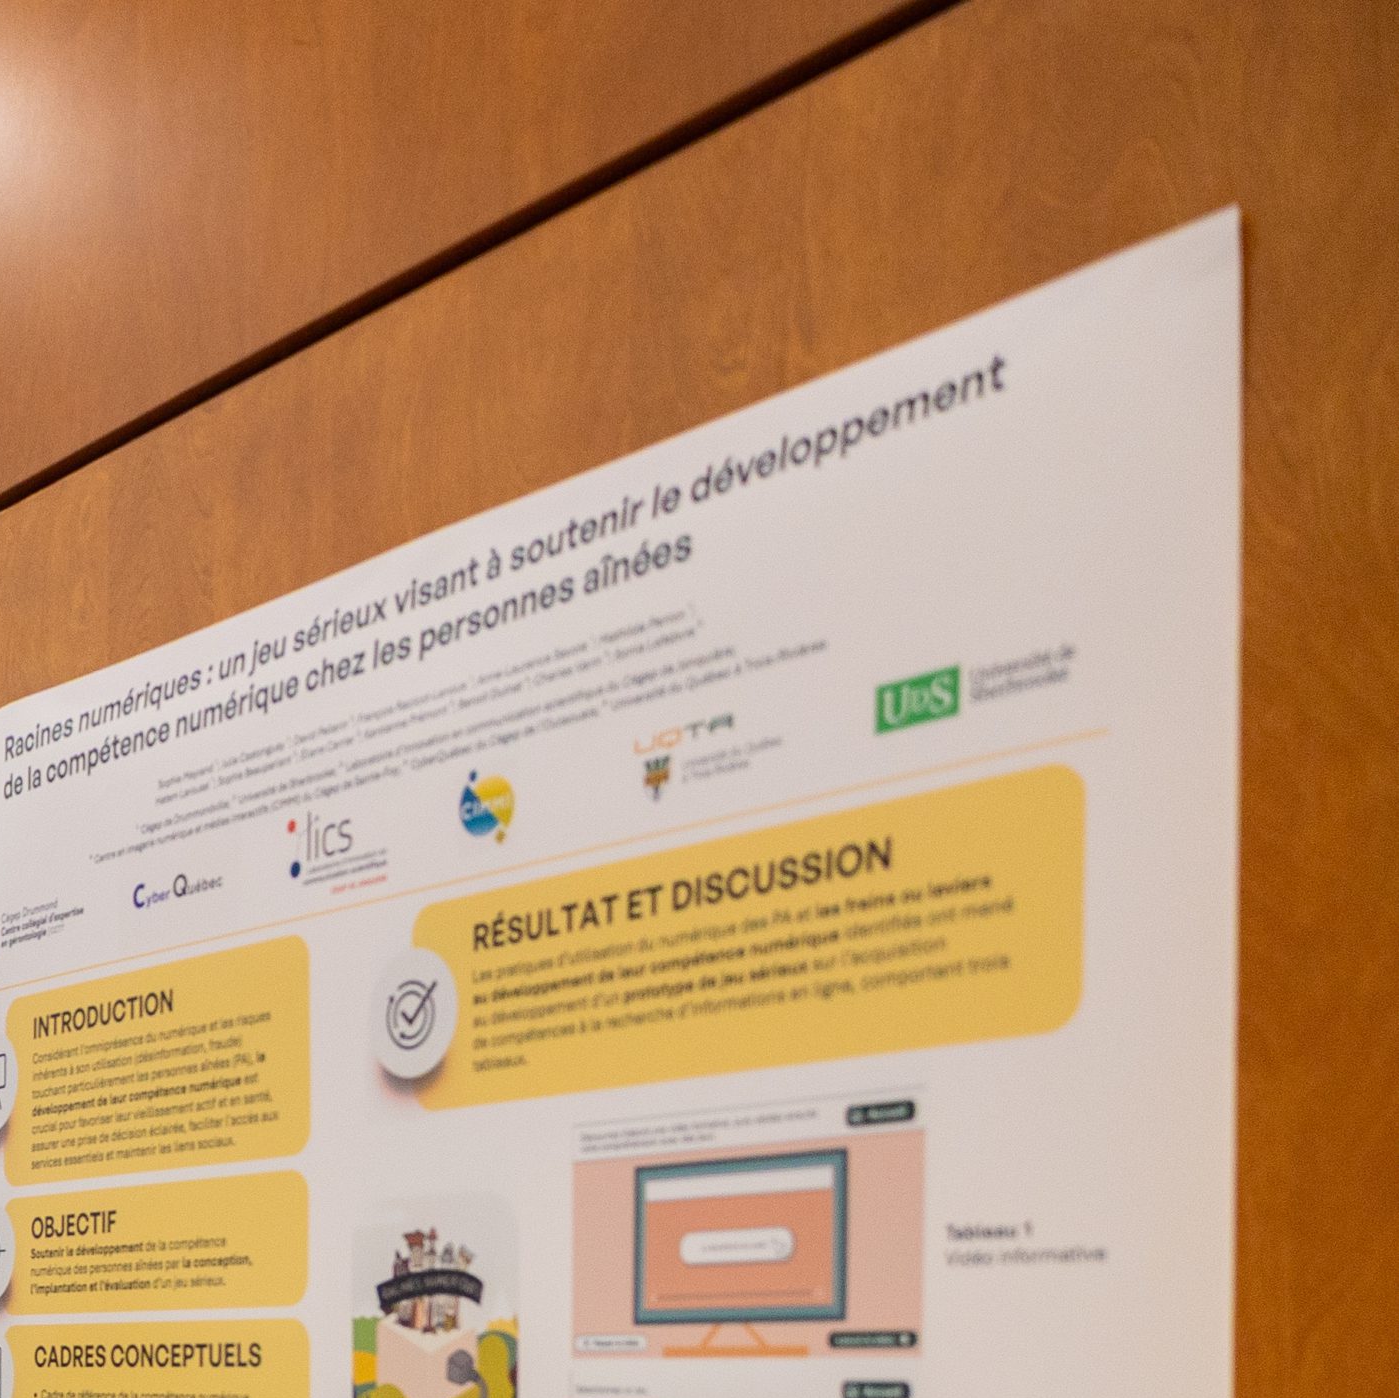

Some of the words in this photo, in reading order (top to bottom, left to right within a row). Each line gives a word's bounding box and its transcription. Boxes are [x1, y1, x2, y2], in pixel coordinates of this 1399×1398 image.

[4, 718, 73, 760] Racines
[78, 669, 201, 731] numériques
[218, 652, 246, 680] un
[248, 636, 287, 676] jeu
[293, 599, 386, 652] sérieux
[394, 559, 478, 613] visant
[485, 548, 501, 581] à
[510, 497, 643, 570] soutenir
[651, 485, 681, 518] le
[690, 358, 1003, 502] développement
[3, 773, 23, 800] de
[27, 766, 42, 791] la
[46, 723, 169, 783] compétence
[175, 676, 298, 736] numérique
[305, 651, 365, 692] chez
[372, 636, 411, 669] les
[419, 578, 574, 659] personnes
[583, 535, 691, 594] aînées
[473, 894, 617, 950] RÉSULTAT
[626, 884, 663, 921] ET
[672, 839, 892, 911] DISCUSSION
[33, 990, 173, 1038] INTRODUCTION
[31, 1210, 116, 1239] OBJECTIF
[34, 1344, 106, 1368] CADRES
[110, 1342, 261, 1368] CONCEPTUELS
